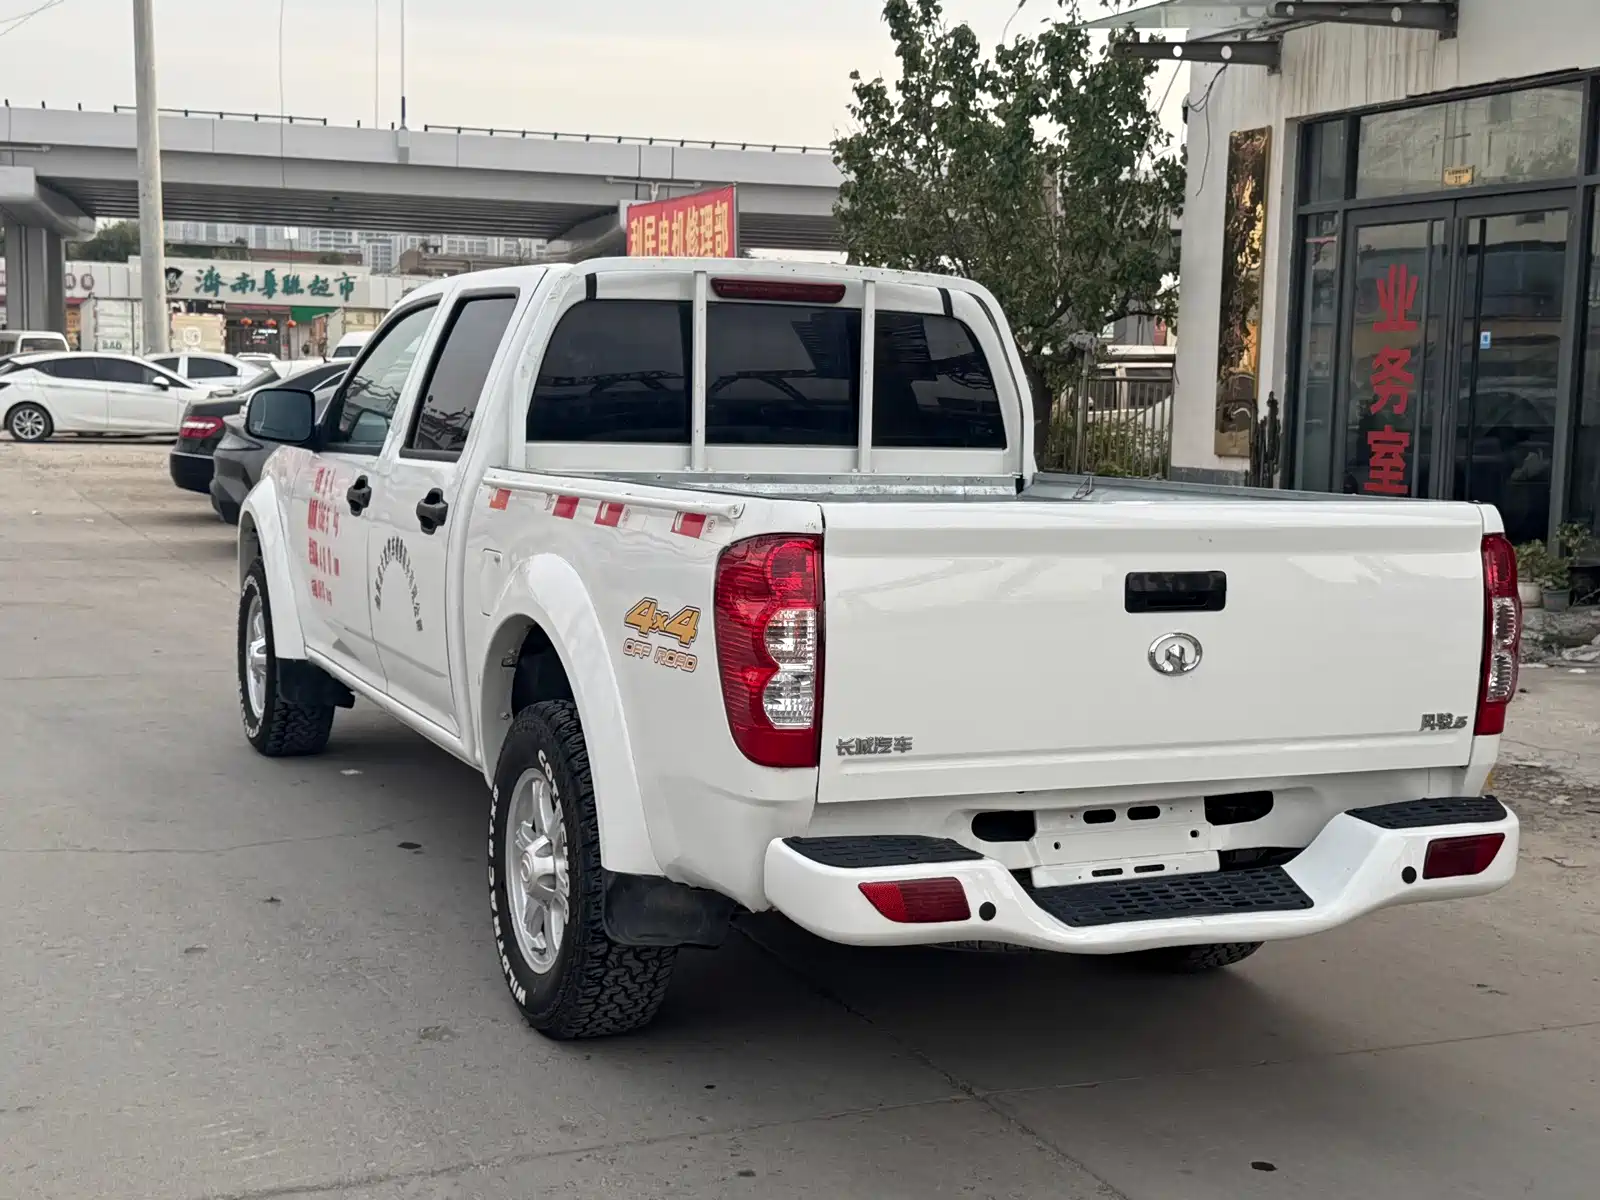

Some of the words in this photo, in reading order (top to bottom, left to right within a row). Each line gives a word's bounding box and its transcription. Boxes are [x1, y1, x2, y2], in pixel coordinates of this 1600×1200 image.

[1363, 263, 1420, 496] 业务室
[623, 638, 652, 659] OFF
[654, 646, 698, 673] ROAD
[836, 736, 913, 756] 长城汽车
